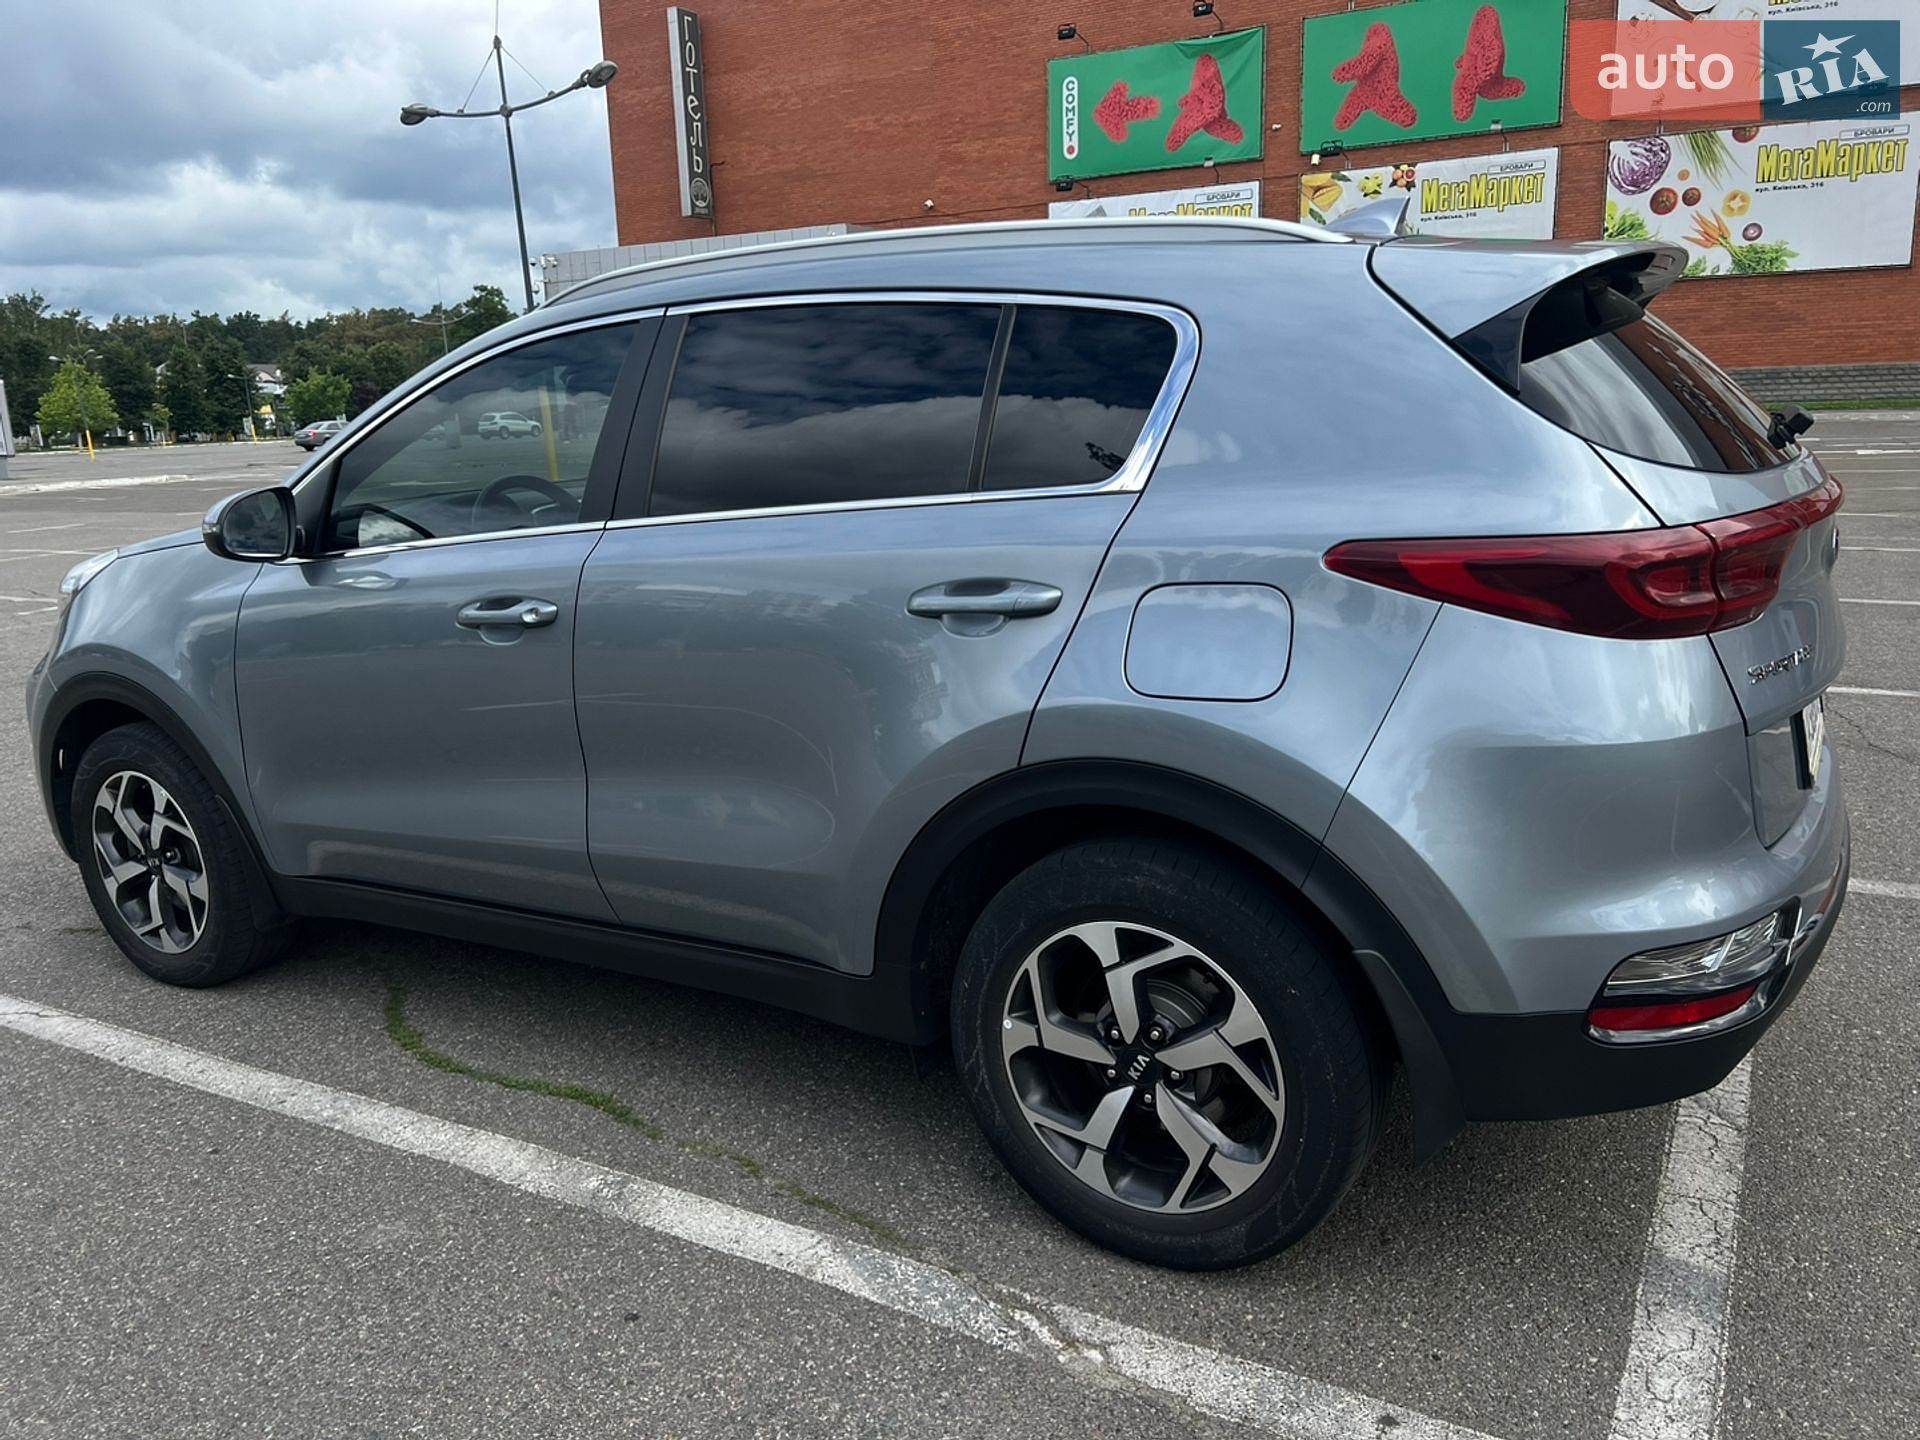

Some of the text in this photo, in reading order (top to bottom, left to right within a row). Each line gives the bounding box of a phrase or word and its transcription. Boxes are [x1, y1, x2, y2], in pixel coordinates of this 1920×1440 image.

[1064, 79, 1076, 142] COMFY
[1853, 127, 1895, 138] БРОВАРИ
[1499, 162, 1534, 173] БРОВАРИ
[1755, 138, 1909, 184] МегаМаркет
[1420, 172, 1545, 214] МегаМаркет
[1127, 1054, 1150, 1080] KIA
